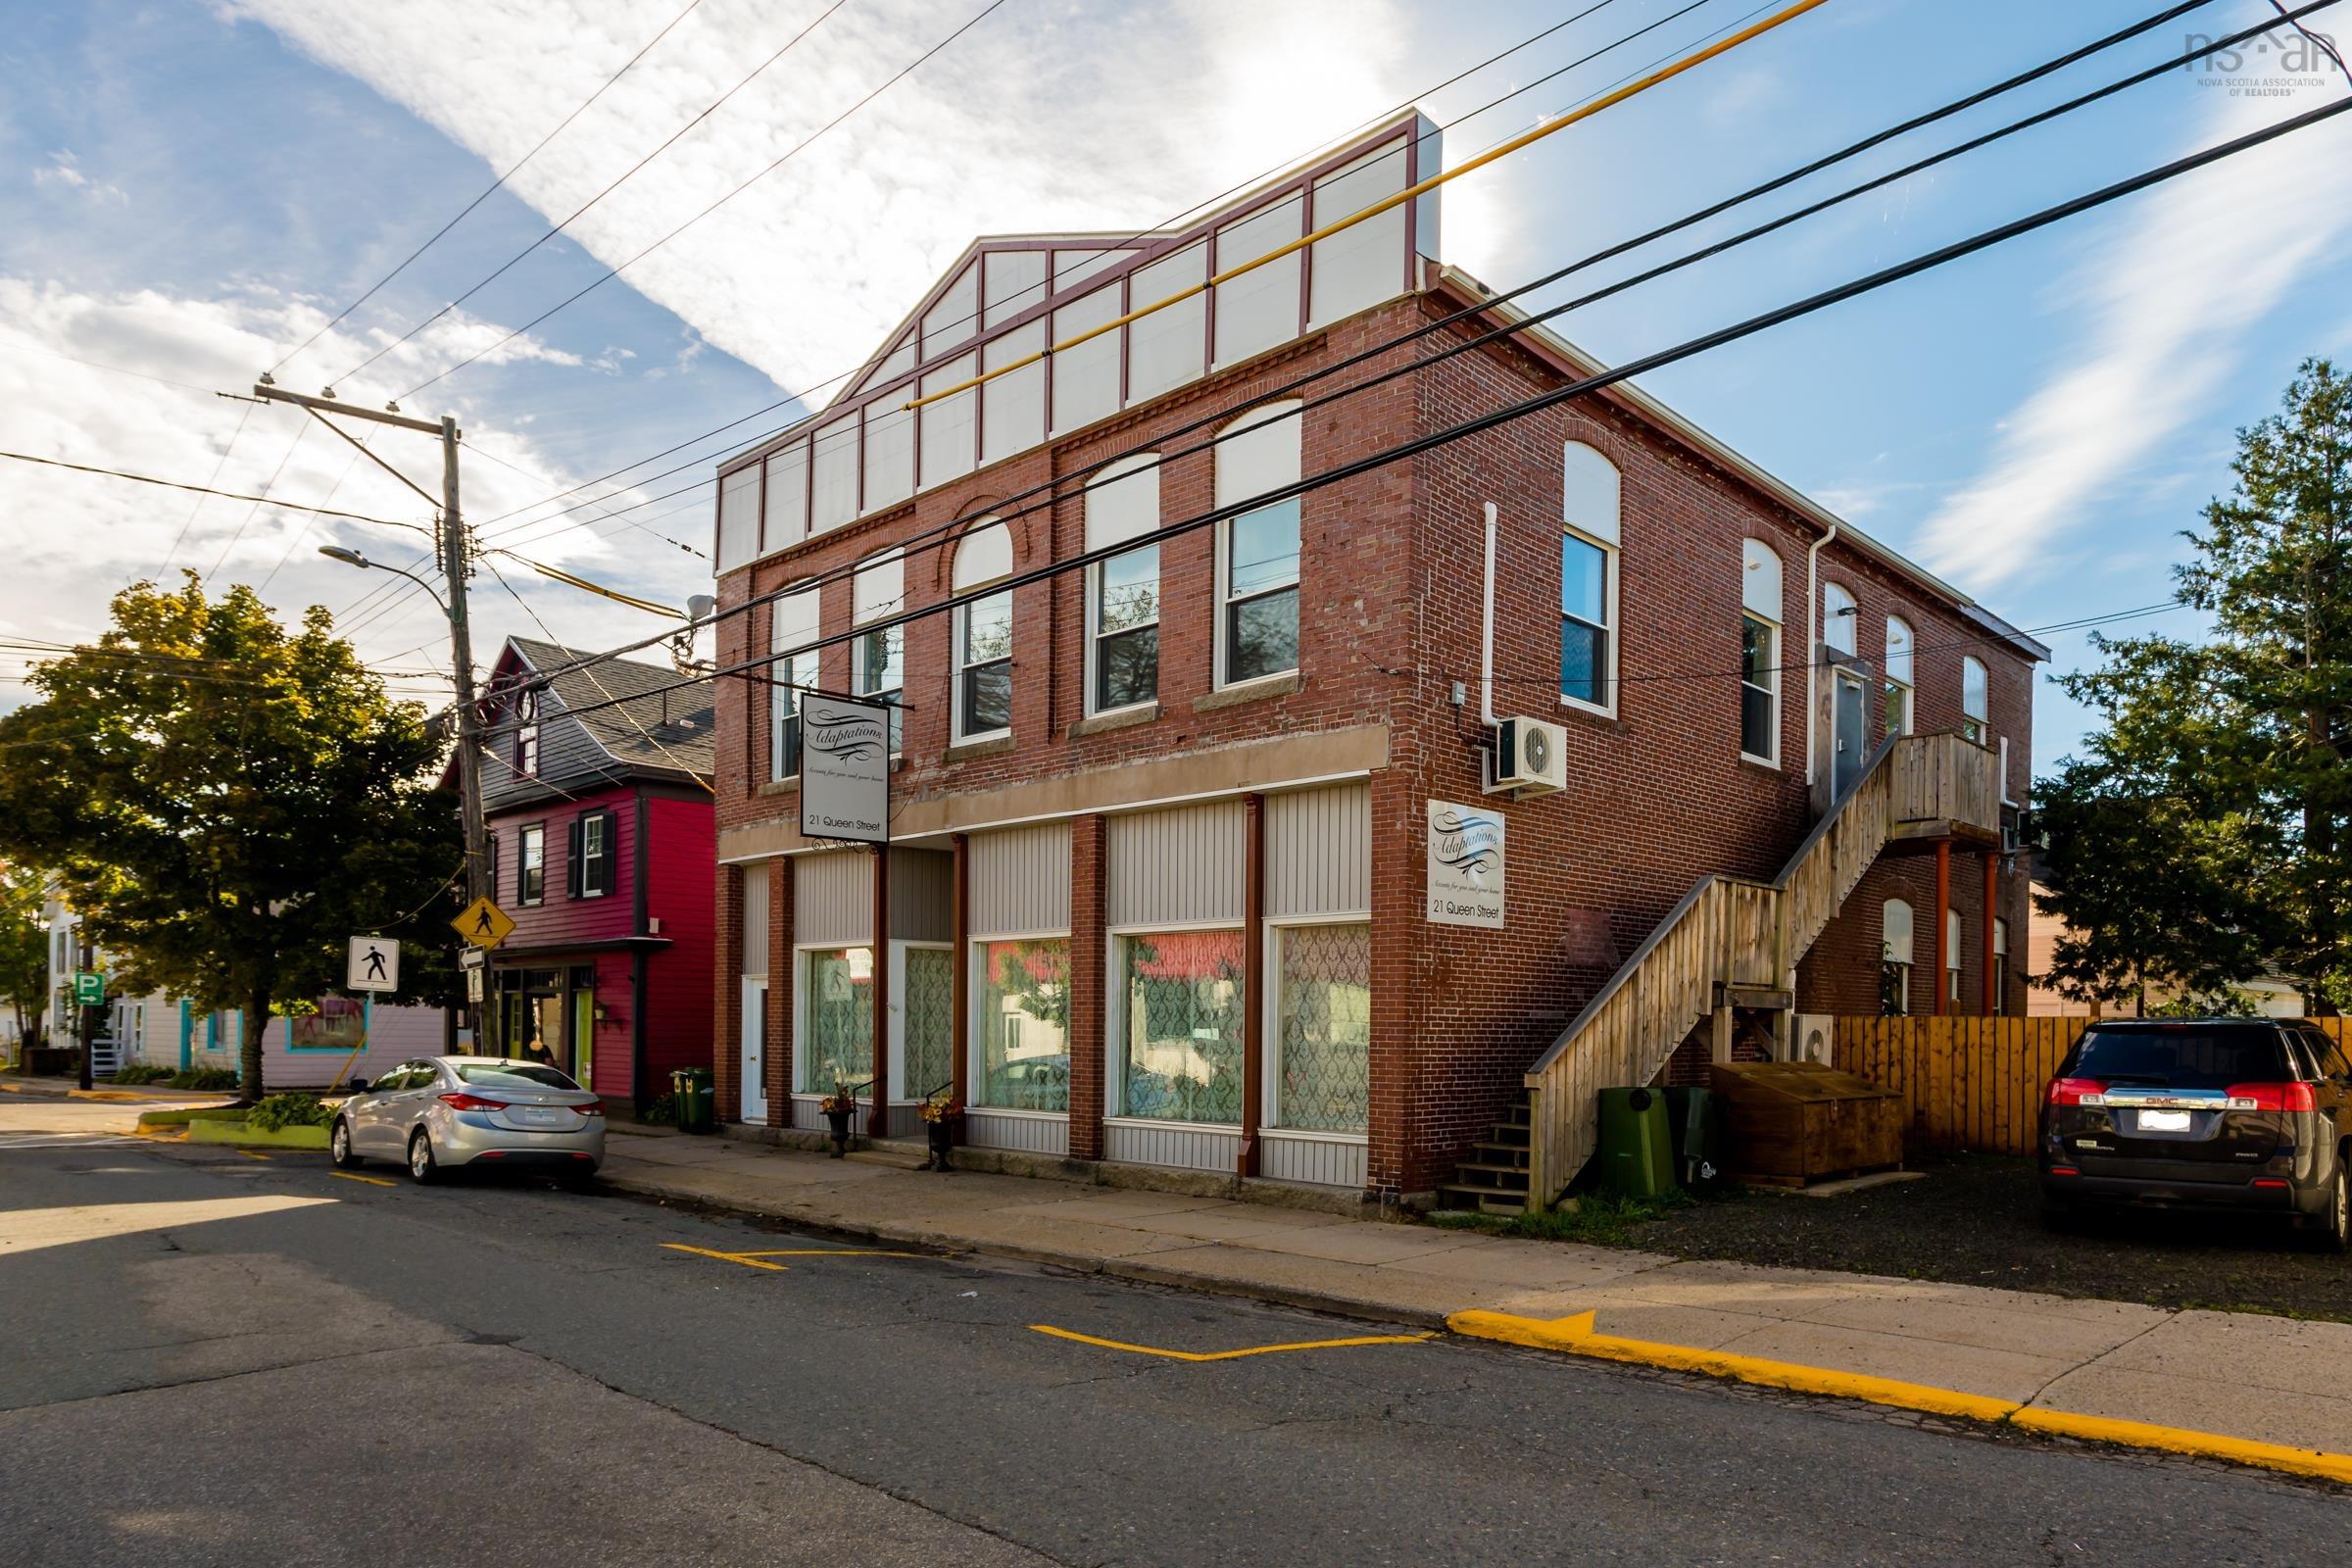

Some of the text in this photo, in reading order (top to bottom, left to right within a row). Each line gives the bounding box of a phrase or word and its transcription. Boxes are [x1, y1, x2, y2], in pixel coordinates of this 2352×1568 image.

[806, 724, 883, 748] Adaptations
[809, 814, 880, 832] 21 Queen Street
[1433, 828, 1498, 859] Adaptations
[1433, 899, 1499, 919] 21 Queen Street
[78, 975, 99, 994] P
